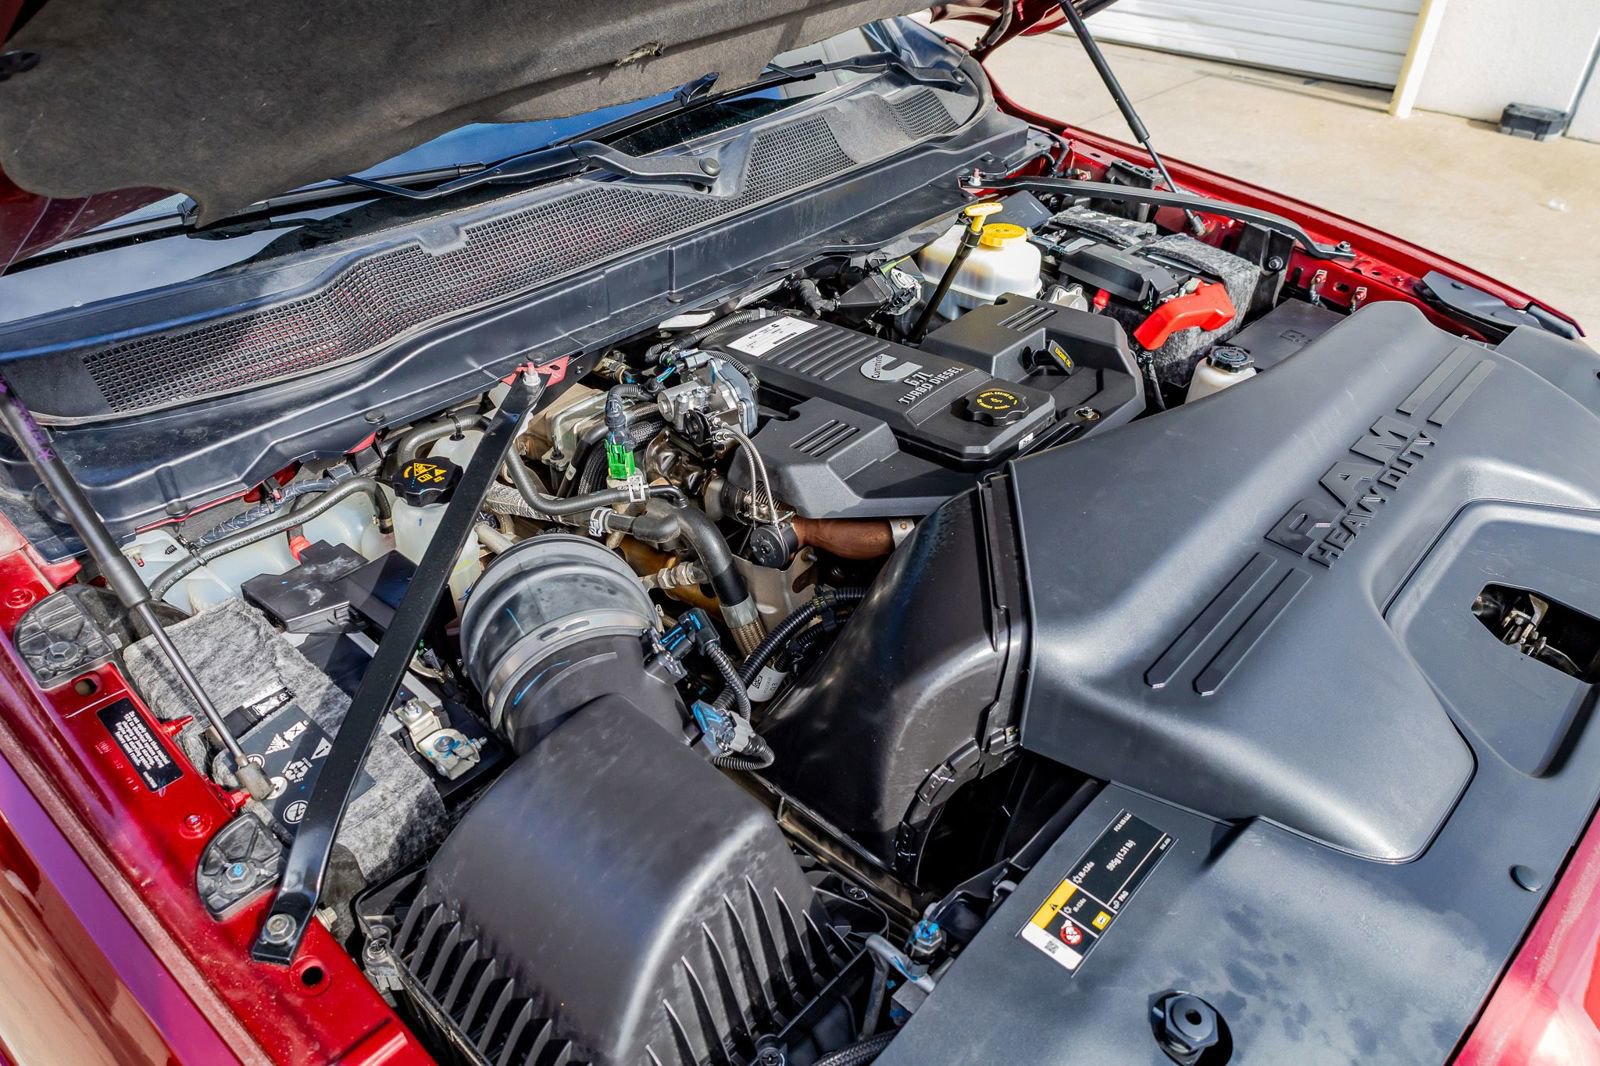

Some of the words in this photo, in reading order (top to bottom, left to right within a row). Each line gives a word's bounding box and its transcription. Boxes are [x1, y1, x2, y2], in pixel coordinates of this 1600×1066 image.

[898, 382, 933, 405] TURBO
[929, 366, 964, 386] DIESEL
[904, 371, 934, 387] 6.7L
[1264, 415, 1418, 556] RAM
[1308, 487, 1389, 568] HEAVY
[1377, 430, 1439, 490] DUTY
[1078, 861, 1095, 878] R-134a
